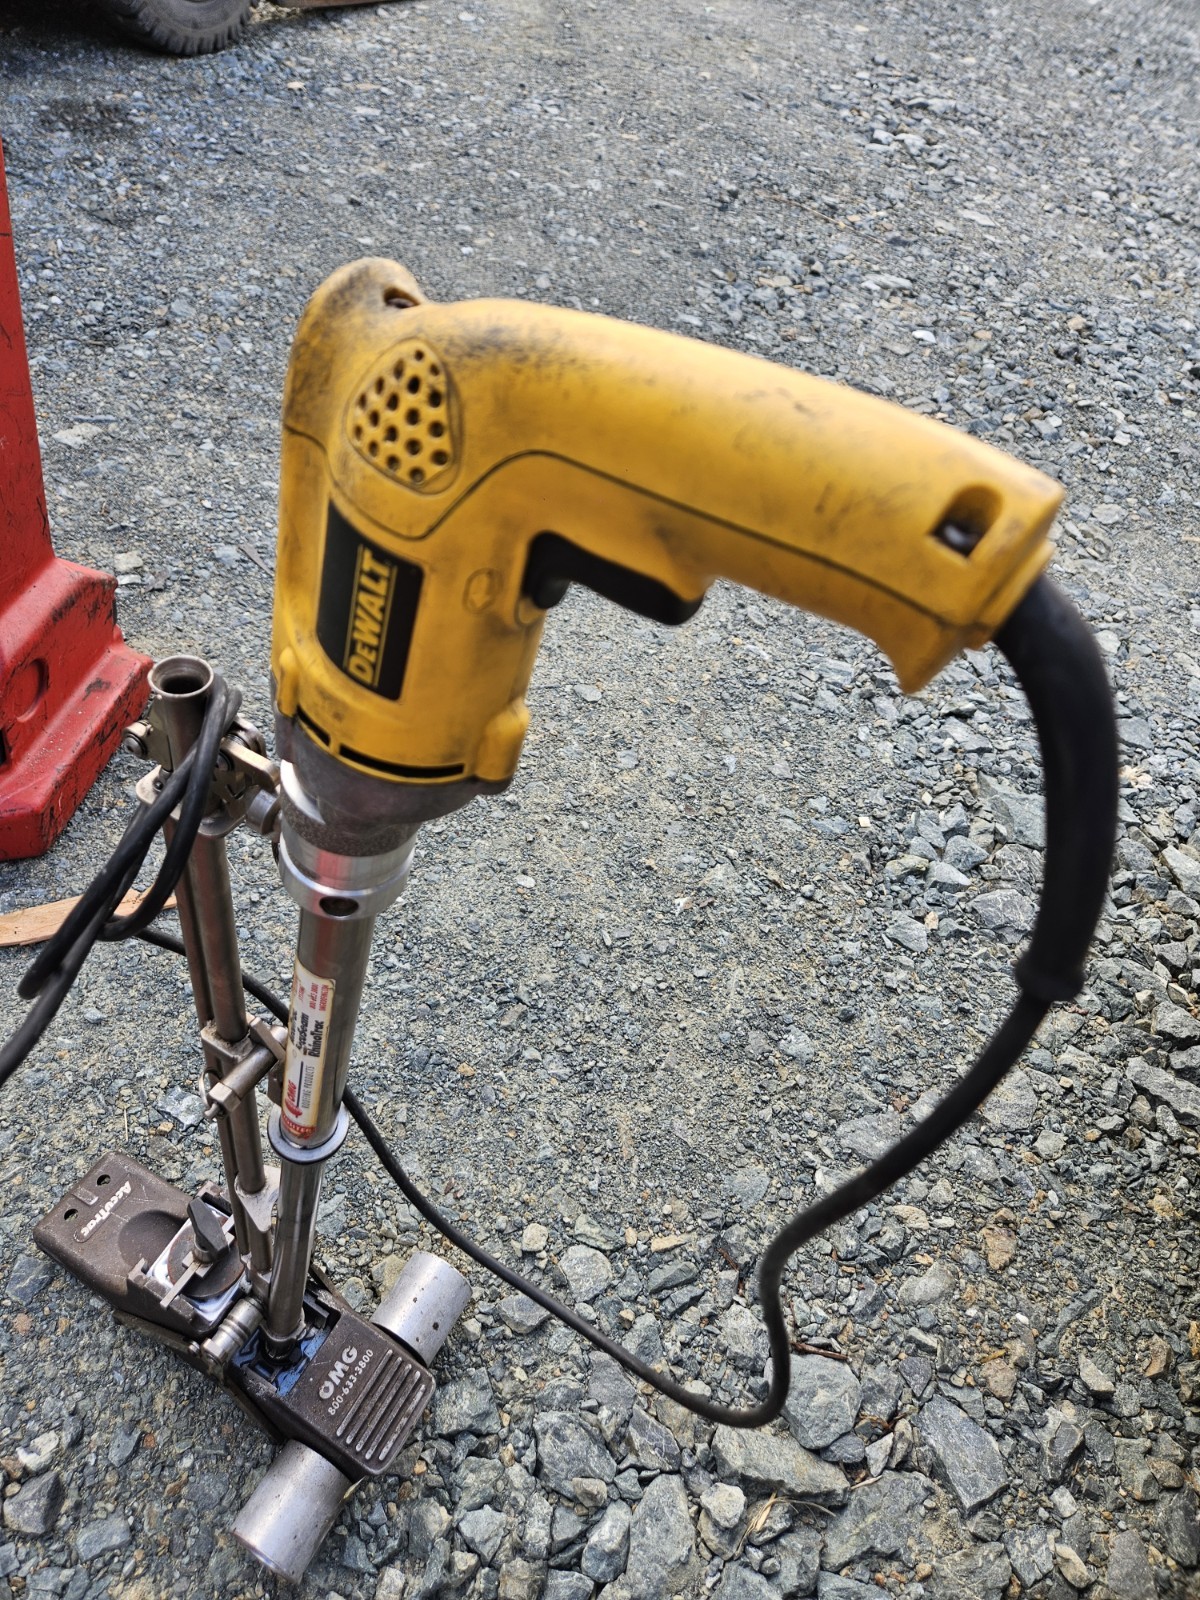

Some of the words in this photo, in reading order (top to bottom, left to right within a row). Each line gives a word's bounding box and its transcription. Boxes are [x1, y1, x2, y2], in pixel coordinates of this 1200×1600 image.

[348, 549, 392, 685] DEWALT
[308, 1019, 325, 1058] RhinoTrac
[287, 1080, 297, 1103] OMG
[304, 1065, 315, 1089] PRODUCTS
[80, 1180, 132, 1237] AccuTrac
[319, 1345, 358, 1400] OMG
[327, 1349, 374, 1416] 800-633-3800
